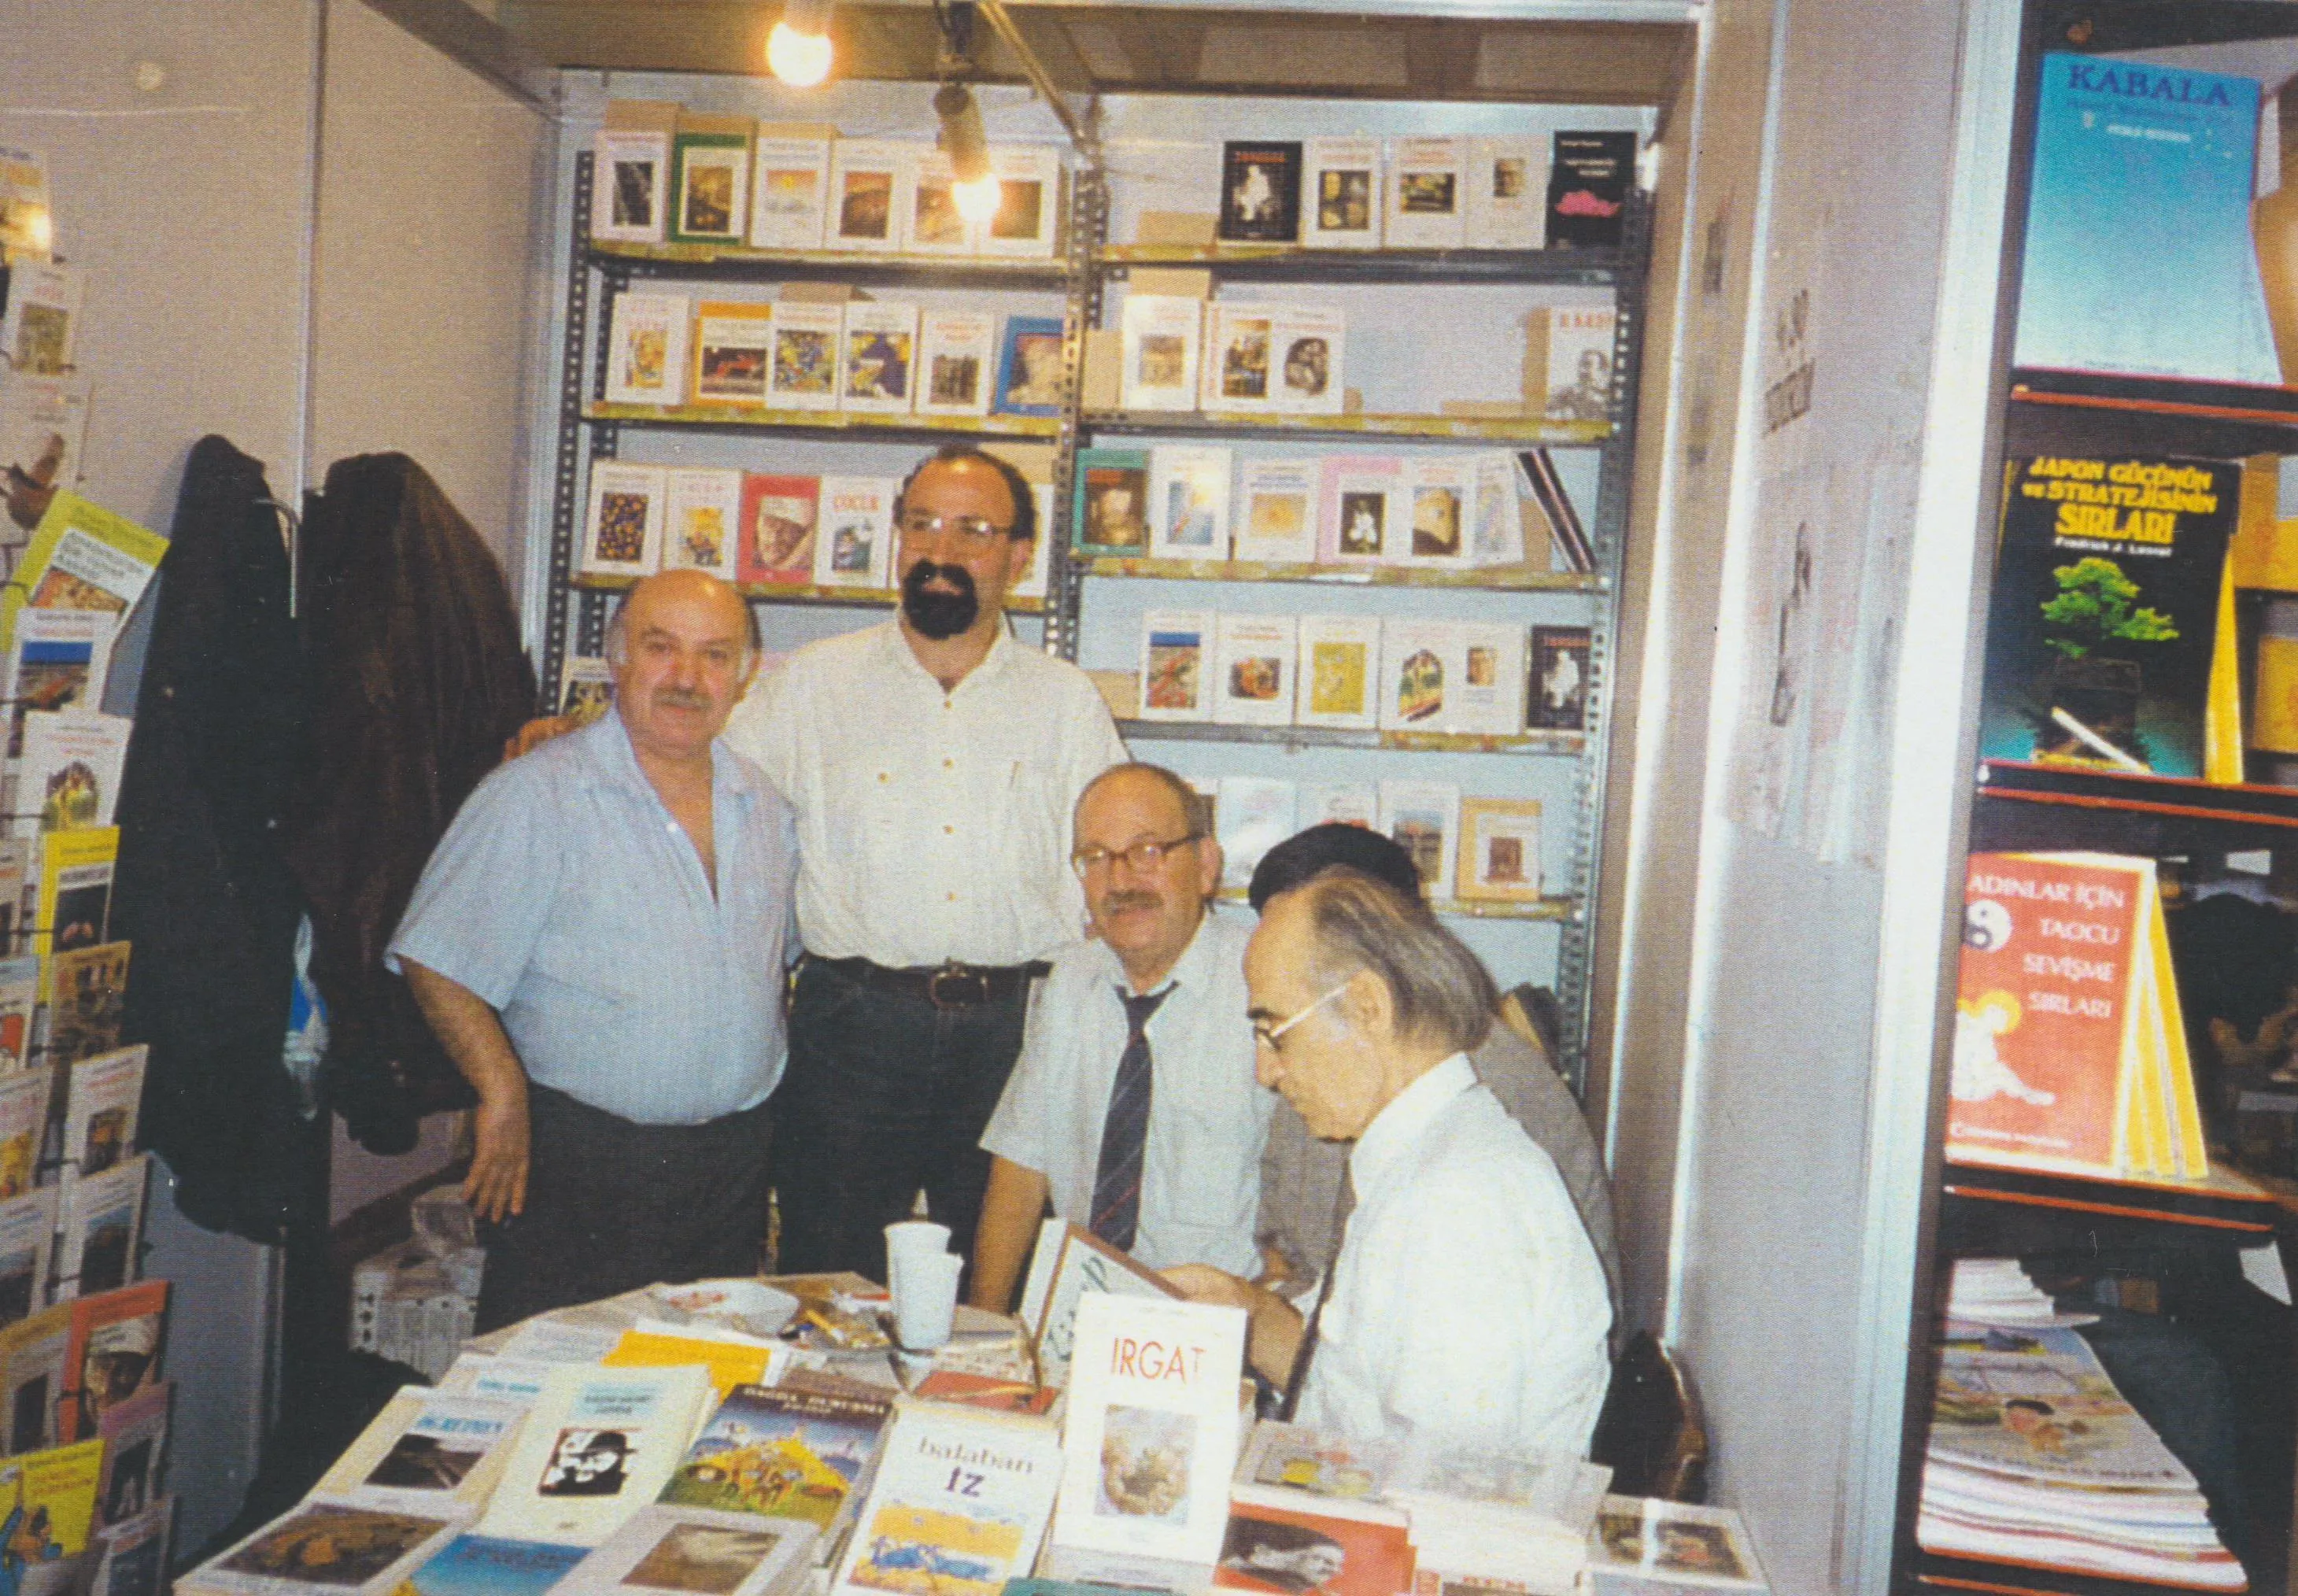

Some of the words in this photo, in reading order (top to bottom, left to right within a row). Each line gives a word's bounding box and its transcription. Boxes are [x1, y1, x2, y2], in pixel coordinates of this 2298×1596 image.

[2067, 64, 2232, 107] KABALA
[2028, 456, 2105, 481] JAPON
[2055, 503, 2177, 545] SIRLARI
[1967, 874, 2071, 903] ADINLAR
[2040, 918, 2121, 945] TAOCU
[2028, 990, 2112, 1018] SIRLARI
[1110, 1336, 1206, 1385] IRGAT
